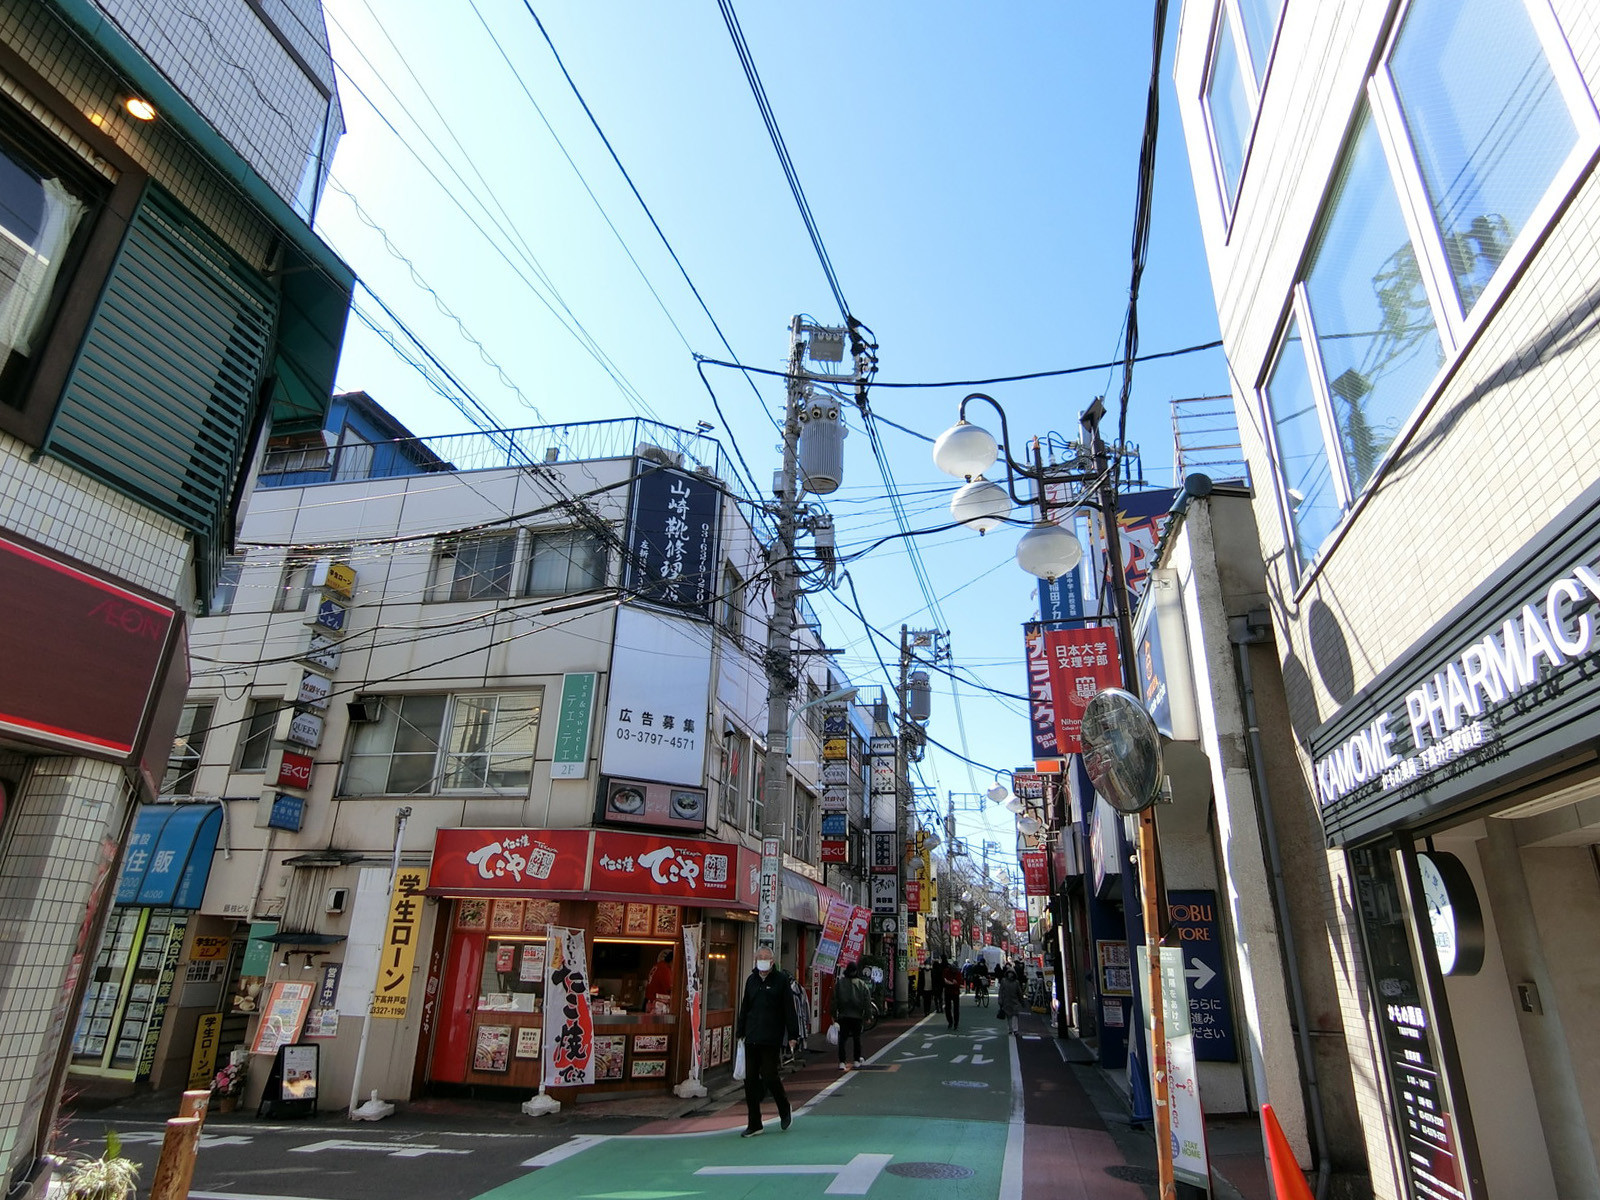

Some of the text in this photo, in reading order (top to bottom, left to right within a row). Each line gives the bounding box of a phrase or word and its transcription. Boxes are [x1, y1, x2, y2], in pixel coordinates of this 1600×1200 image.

[1055, 641, 1108, 659] 日本大学
[1058, 652, 1109, 669] 文理学部
[1029, 635, 1055, 730] カラオケ
[292, 721, 319, 738] QUEEN
[618, 708, 696, 734] 広告募集
[616, 727, 695, 750] 03-3797-4571
[281, 762, 310, 779] 宝くじ
[561, 764, 575, 775] 2F
[1315, 711, 1402, 805] KAMOME
[125, 849, 176, 873] 住販
[466, 842, 527, 882] てこや
[637, 845, 700, 889] てこや
[761, 874, 771, 905] 立花
[1168, 905, 1213, 922] TOBU
[384, 873, 421, 992] 学生ローン
[323, 967, 338, 1000] 営業中
[374, 995, 407, 1006] 下高井戸店
[197, 1016, 217, 1071] 学生ローン
